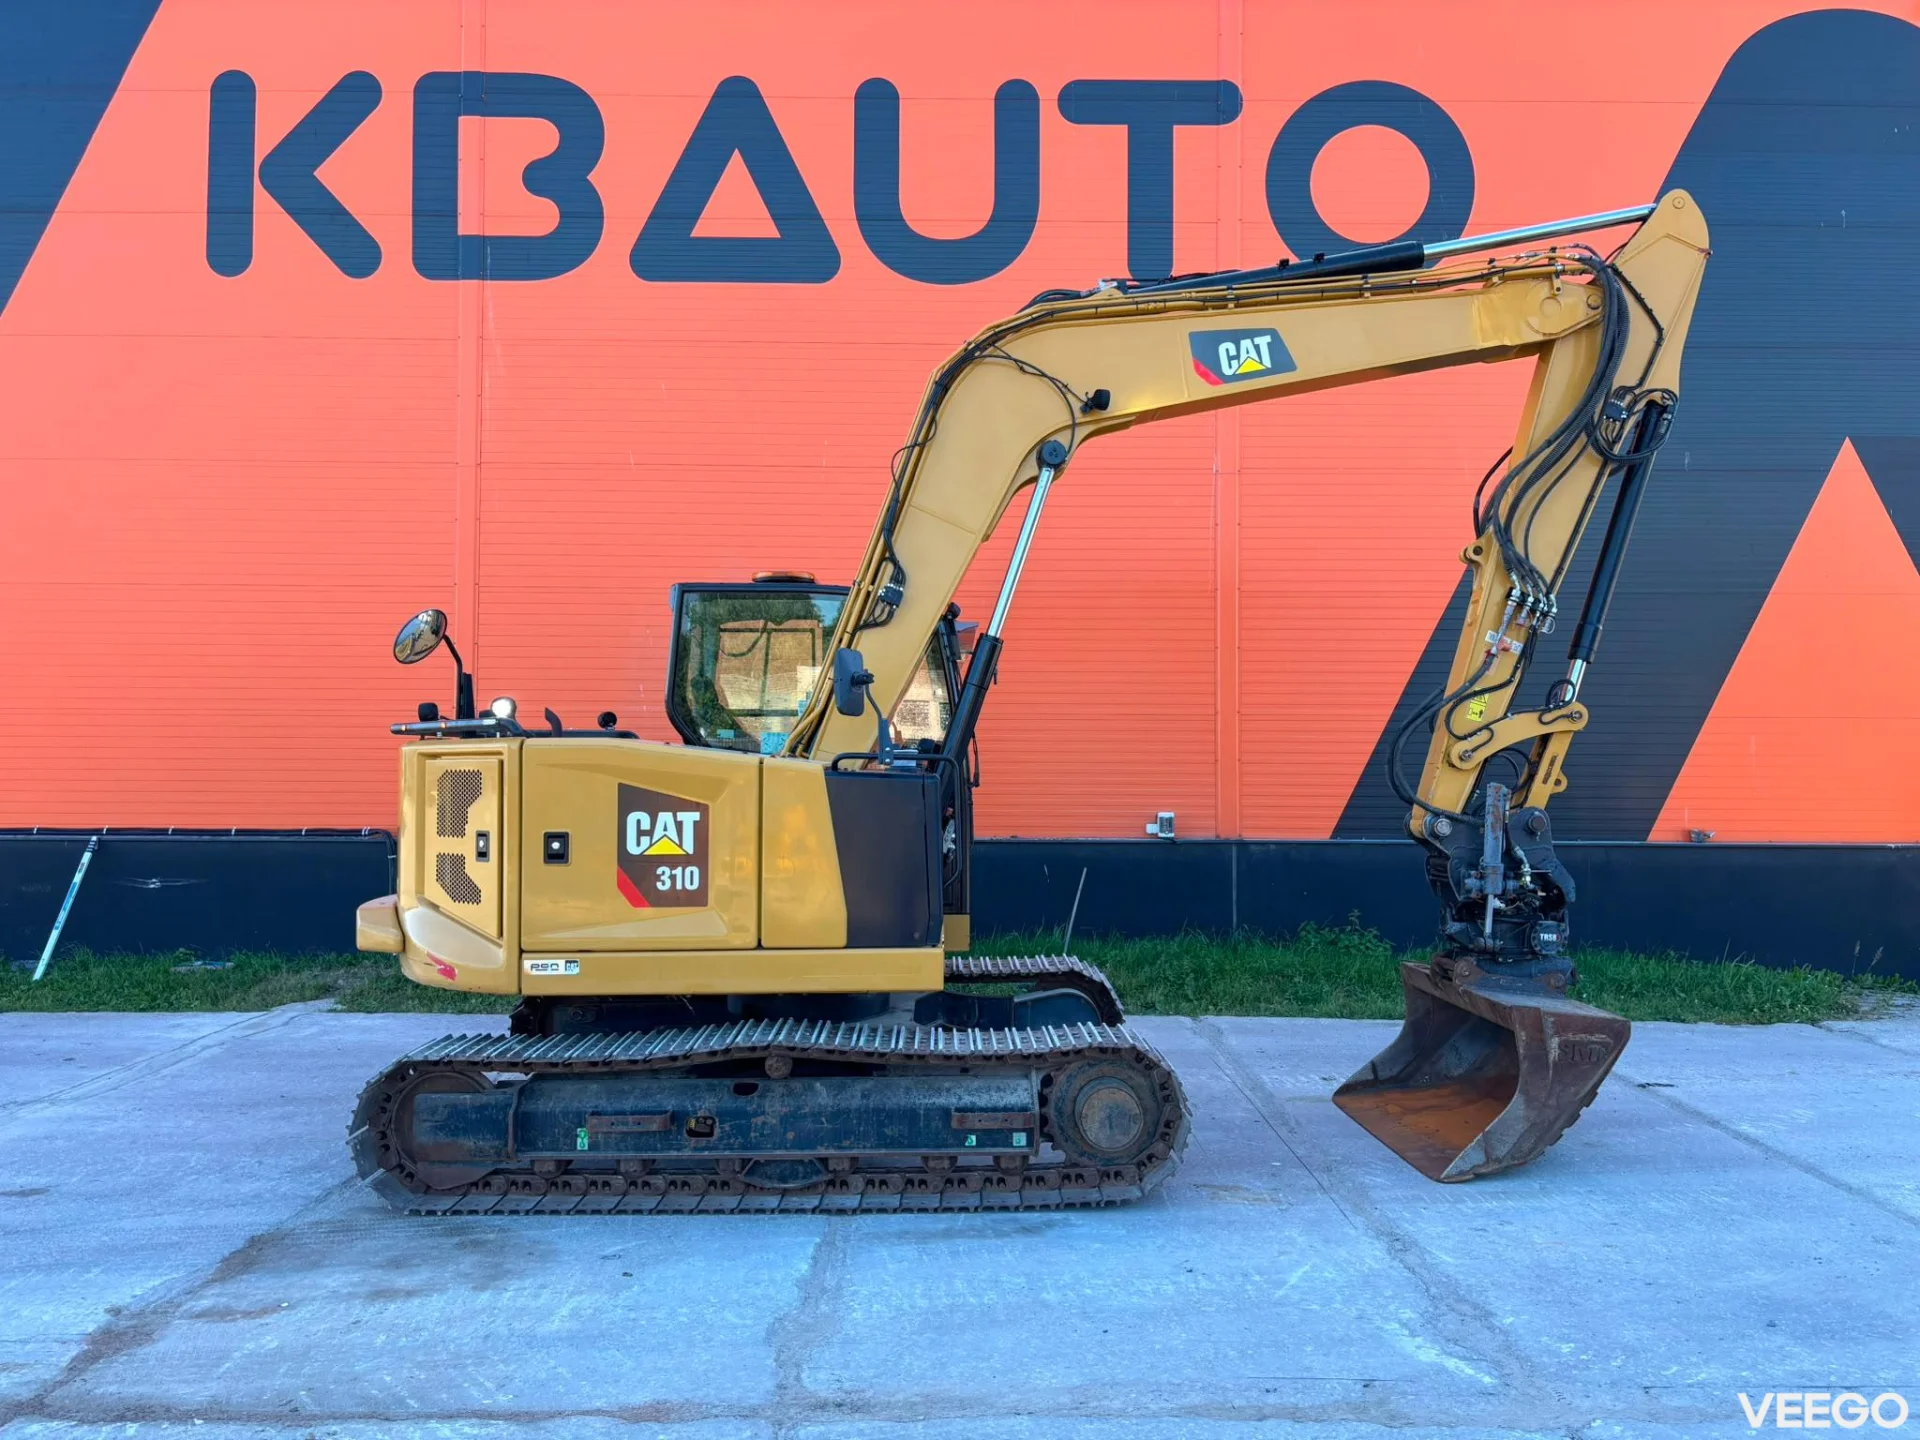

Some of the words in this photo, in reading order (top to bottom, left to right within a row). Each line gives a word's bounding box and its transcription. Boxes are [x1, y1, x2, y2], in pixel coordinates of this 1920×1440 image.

[206, 68, 1475, 285] KBAUTO
[1218, 335, 1272, 376] CAT
[626, 811, 700, 855] CAT
[656, 866, 700, 890] 310
